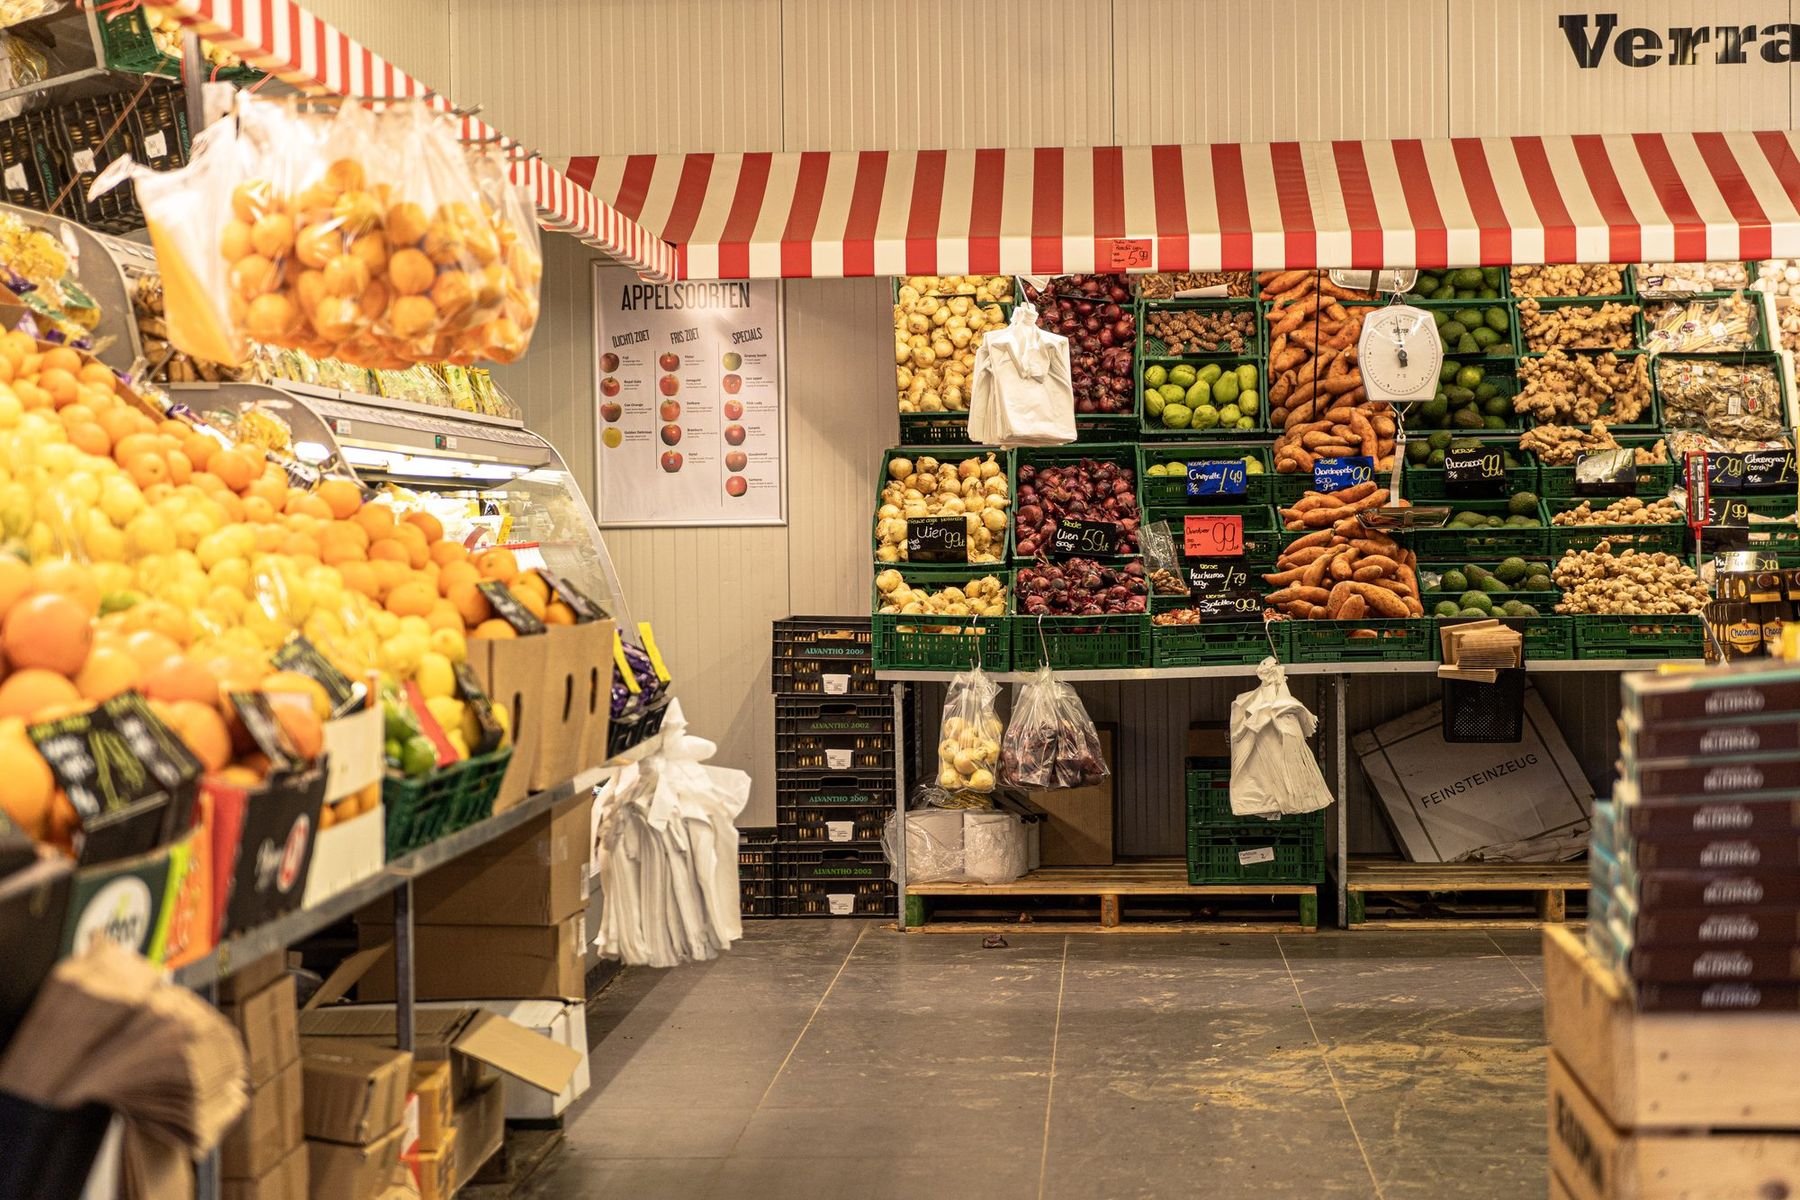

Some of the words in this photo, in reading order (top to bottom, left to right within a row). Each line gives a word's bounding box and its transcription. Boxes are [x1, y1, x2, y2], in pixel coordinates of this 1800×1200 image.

[1558, 13, 1800, 68] Verra
[621, 282, 750, 311] APPELSOORTEN
[634, 329, 650, 344] ZOET
[670, 331, 685, 345] FRIS
[685, 327, 699, 342] ZOET
[732, 327, 763, 345] SPECIALS
[916, 526, 947, 539] Uien
[1057, 528, 1079, 540] Uien
[805, 647, 844, 655] ALVANTHO
[1421, 753, 1539, 809] FEINSTEINZEUG
[809, 795, 848, 803] ALVANTHO
